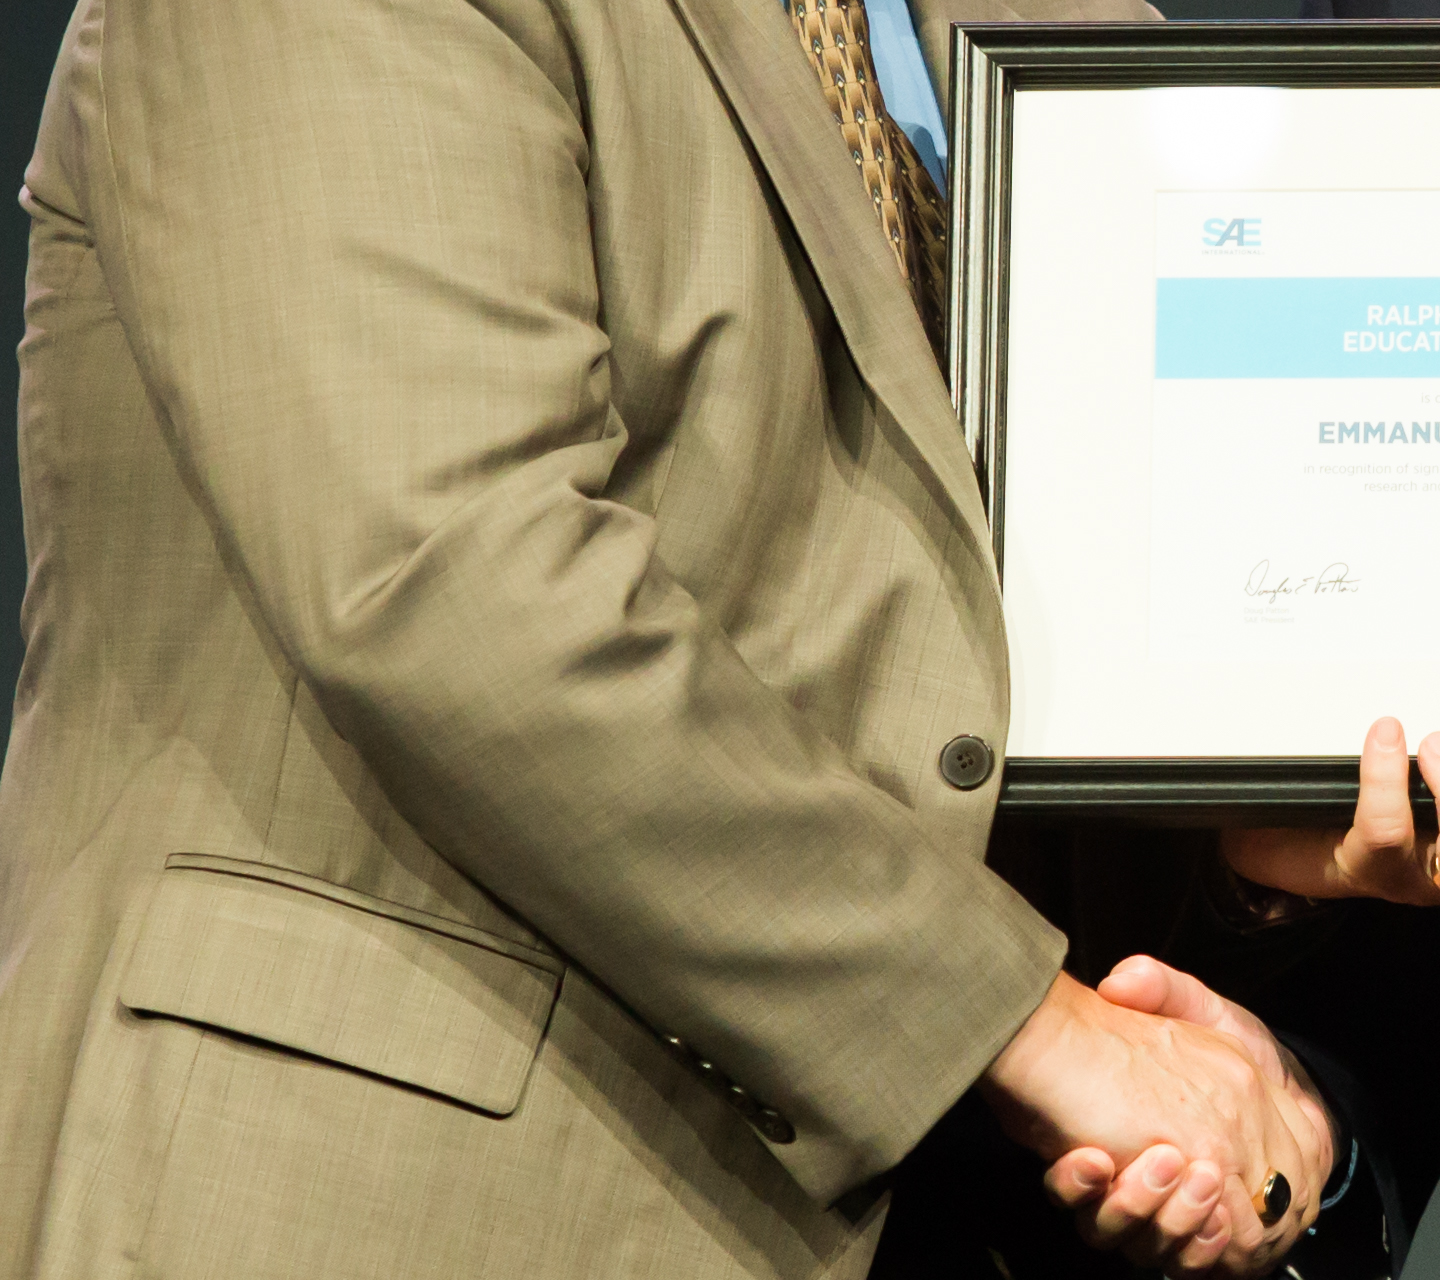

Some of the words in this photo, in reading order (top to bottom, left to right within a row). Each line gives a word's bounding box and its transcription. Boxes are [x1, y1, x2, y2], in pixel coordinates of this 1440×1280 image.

[1202, 218, 1262, 247] SAE
[1420, 391, 1432, 404] is
[1303, 463, 1316, 475] in
[1319, 462, 1393, 477] recognition
[1396, 461, 1410, 475] of
[1363, 479, 1419, 493] research
